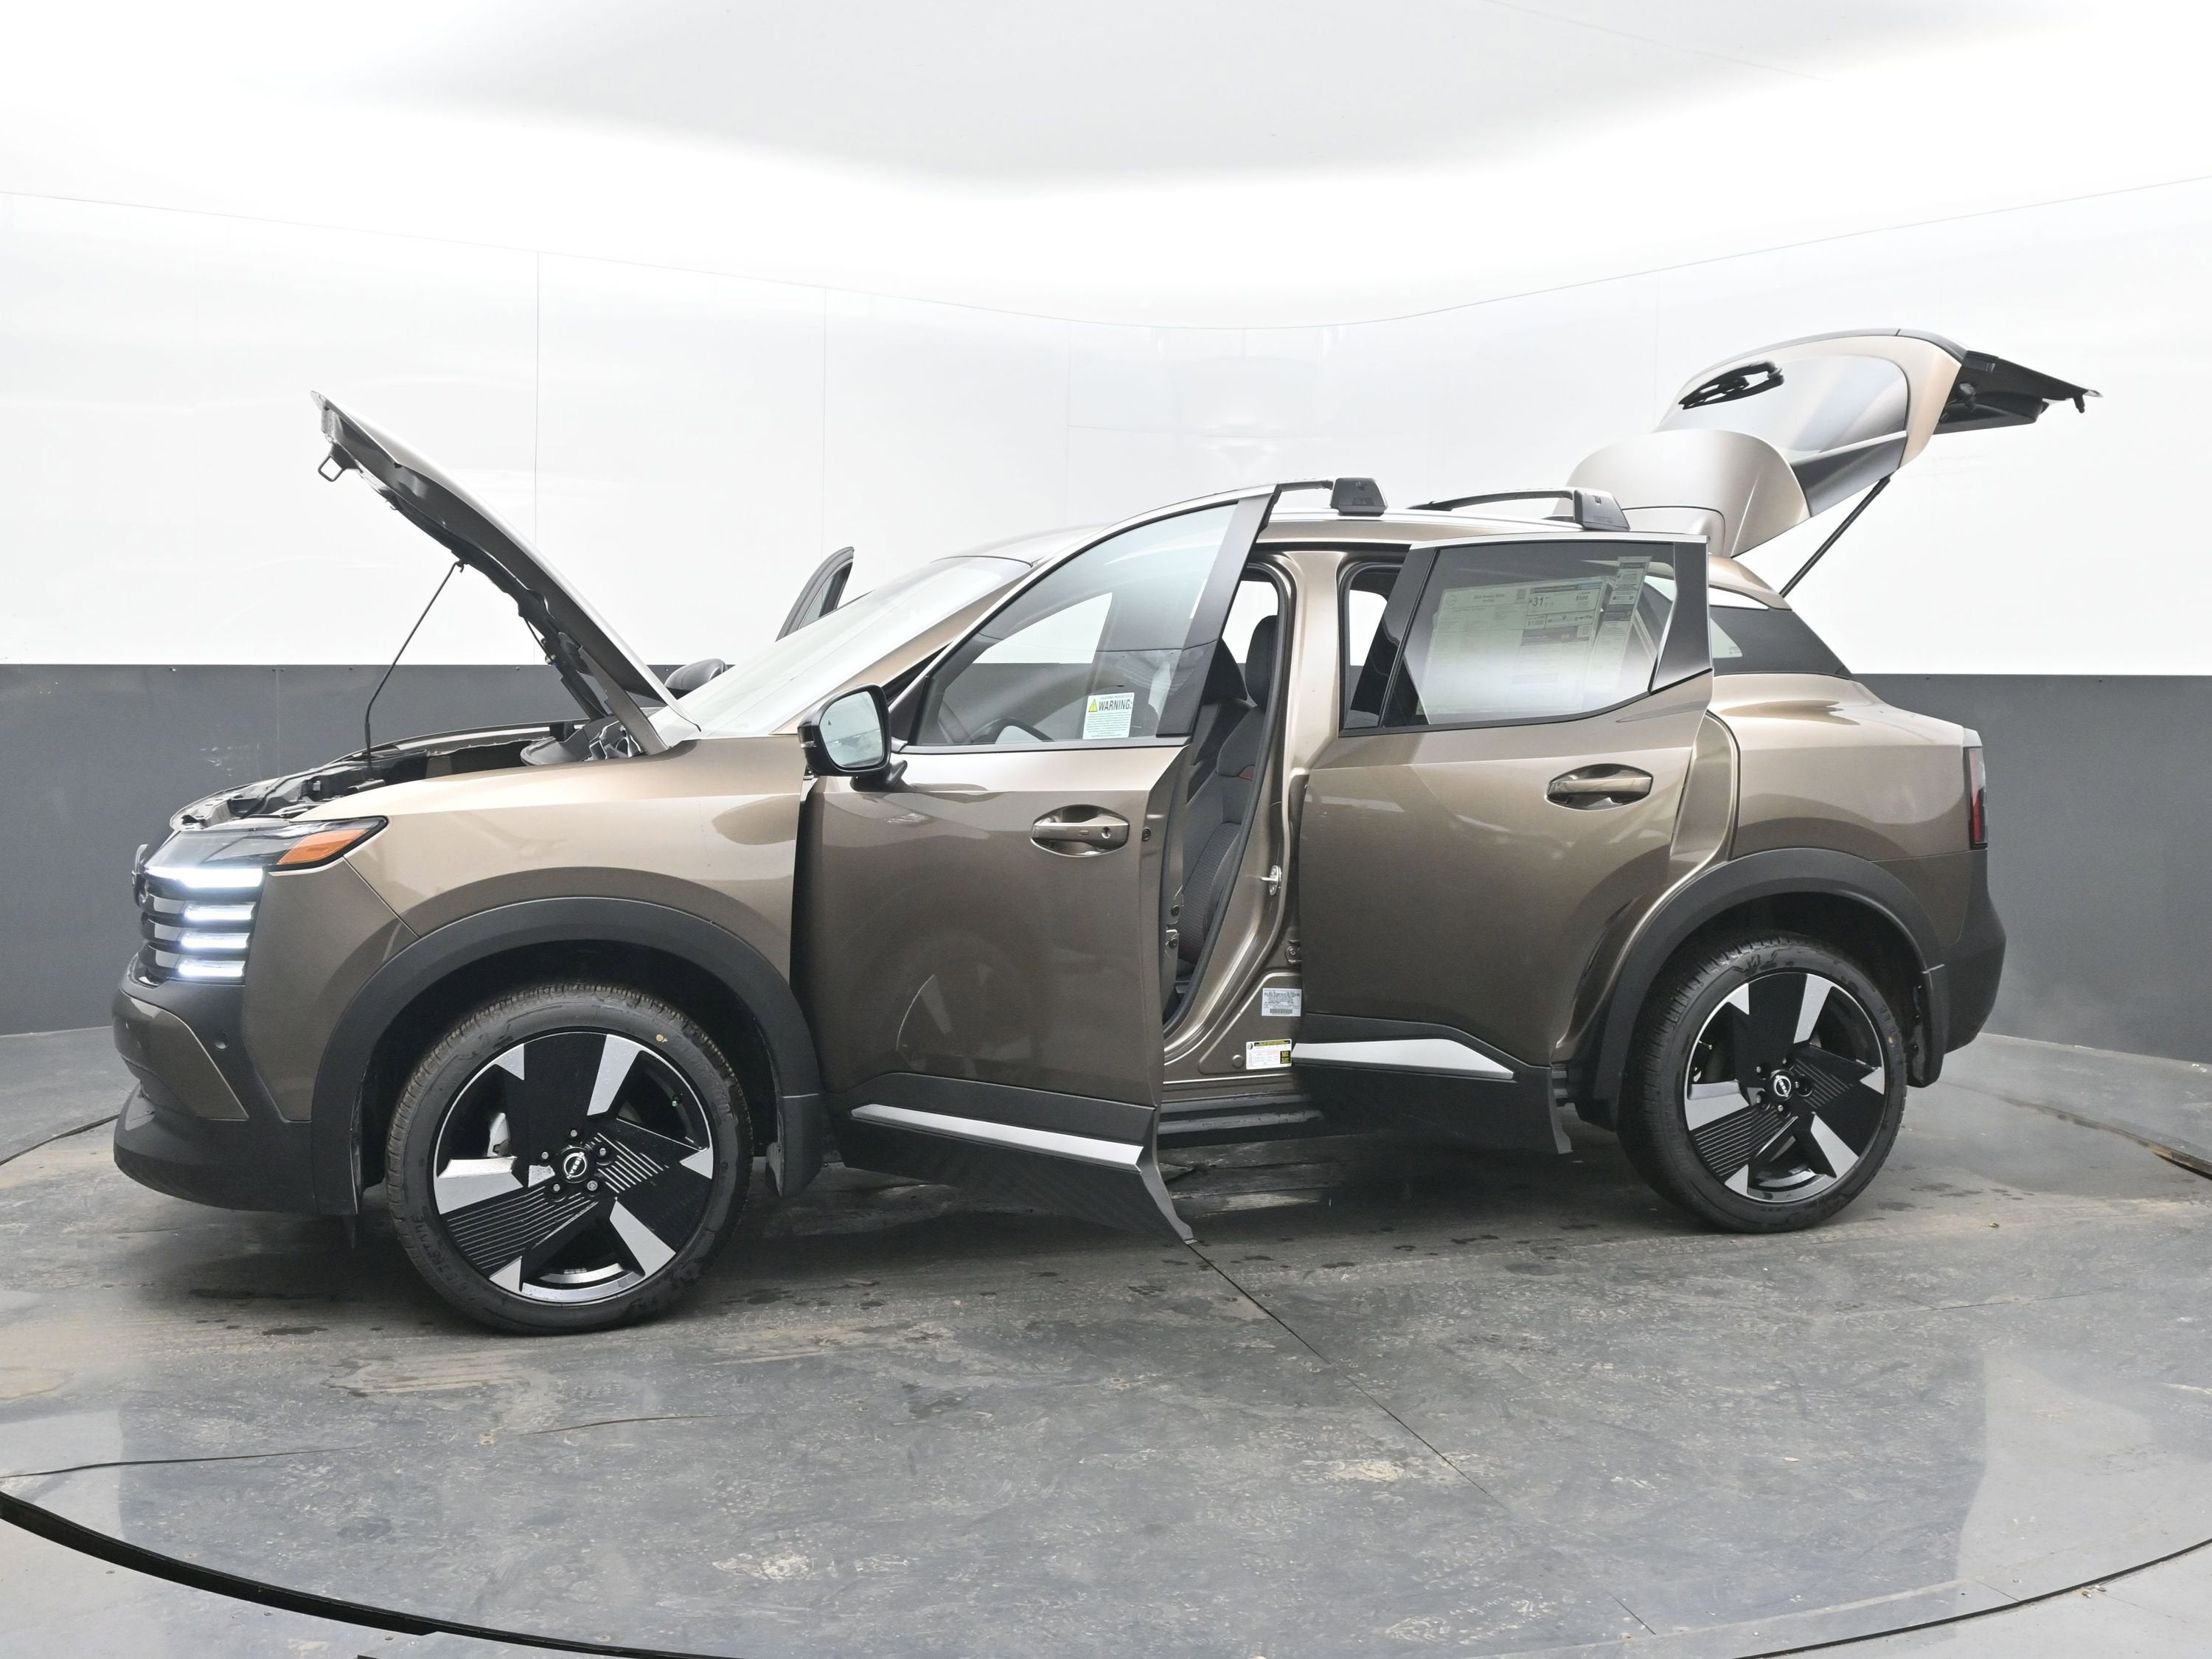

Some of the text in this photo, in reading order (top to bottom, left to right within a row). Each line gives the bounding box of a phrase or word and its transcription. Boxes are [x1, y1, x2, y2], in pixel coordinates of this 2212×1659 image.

[1533, 597, 1544, 607] 31
[1099, 699, 1133, 712] WARNING:
[566, 1152, 585, 1180] NISSAN
